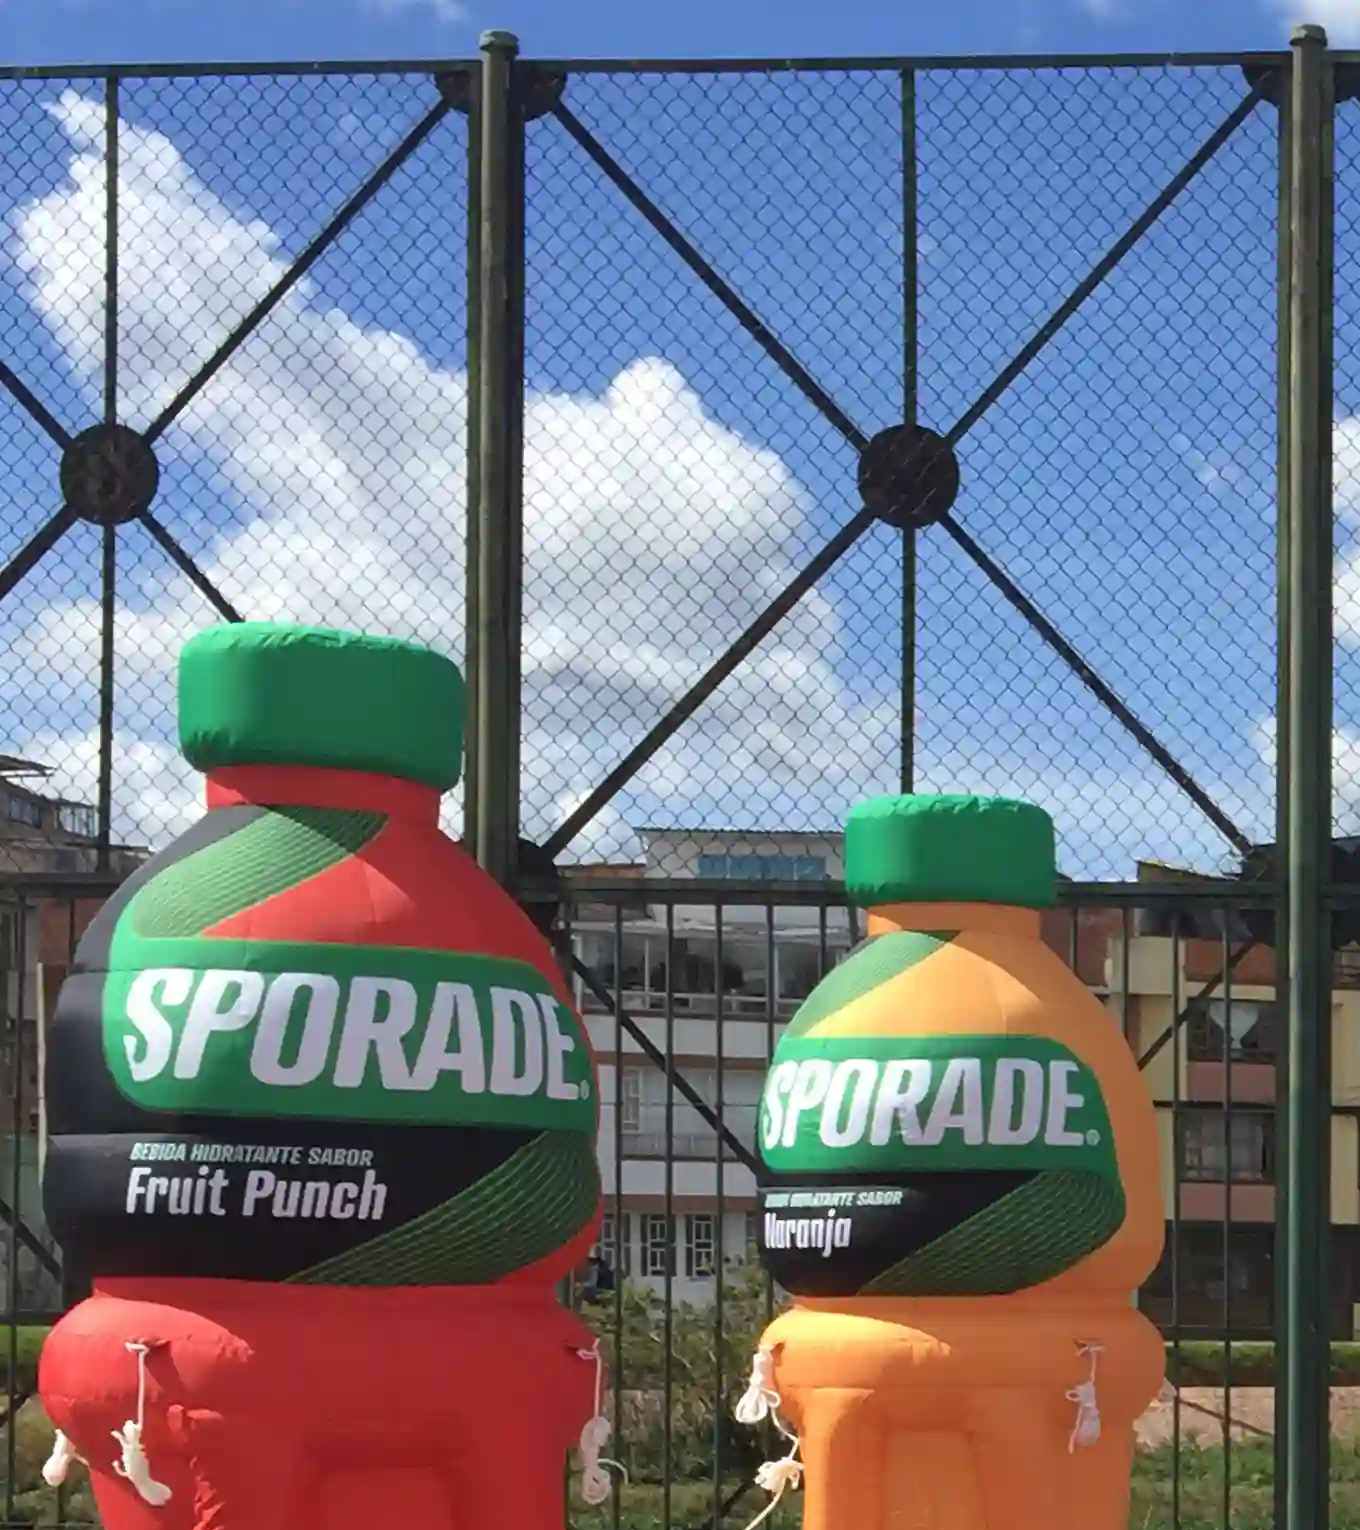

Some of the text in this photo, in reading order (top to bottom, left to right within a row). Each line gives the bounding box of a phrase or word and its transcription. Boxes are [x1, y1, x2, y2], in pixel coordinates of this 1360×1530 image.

[123, 968, 579, 1099] SPORADE
[763, 1058, 1085, 1150] SPORADE
[190, 1143, 303, 1165] HIDRATANTE
[307, 1148, 374, 1167] SABOR
[126, 1165, 388, 1220] Fruit Punch
[764, 1208, 852, 1258] Naranja
